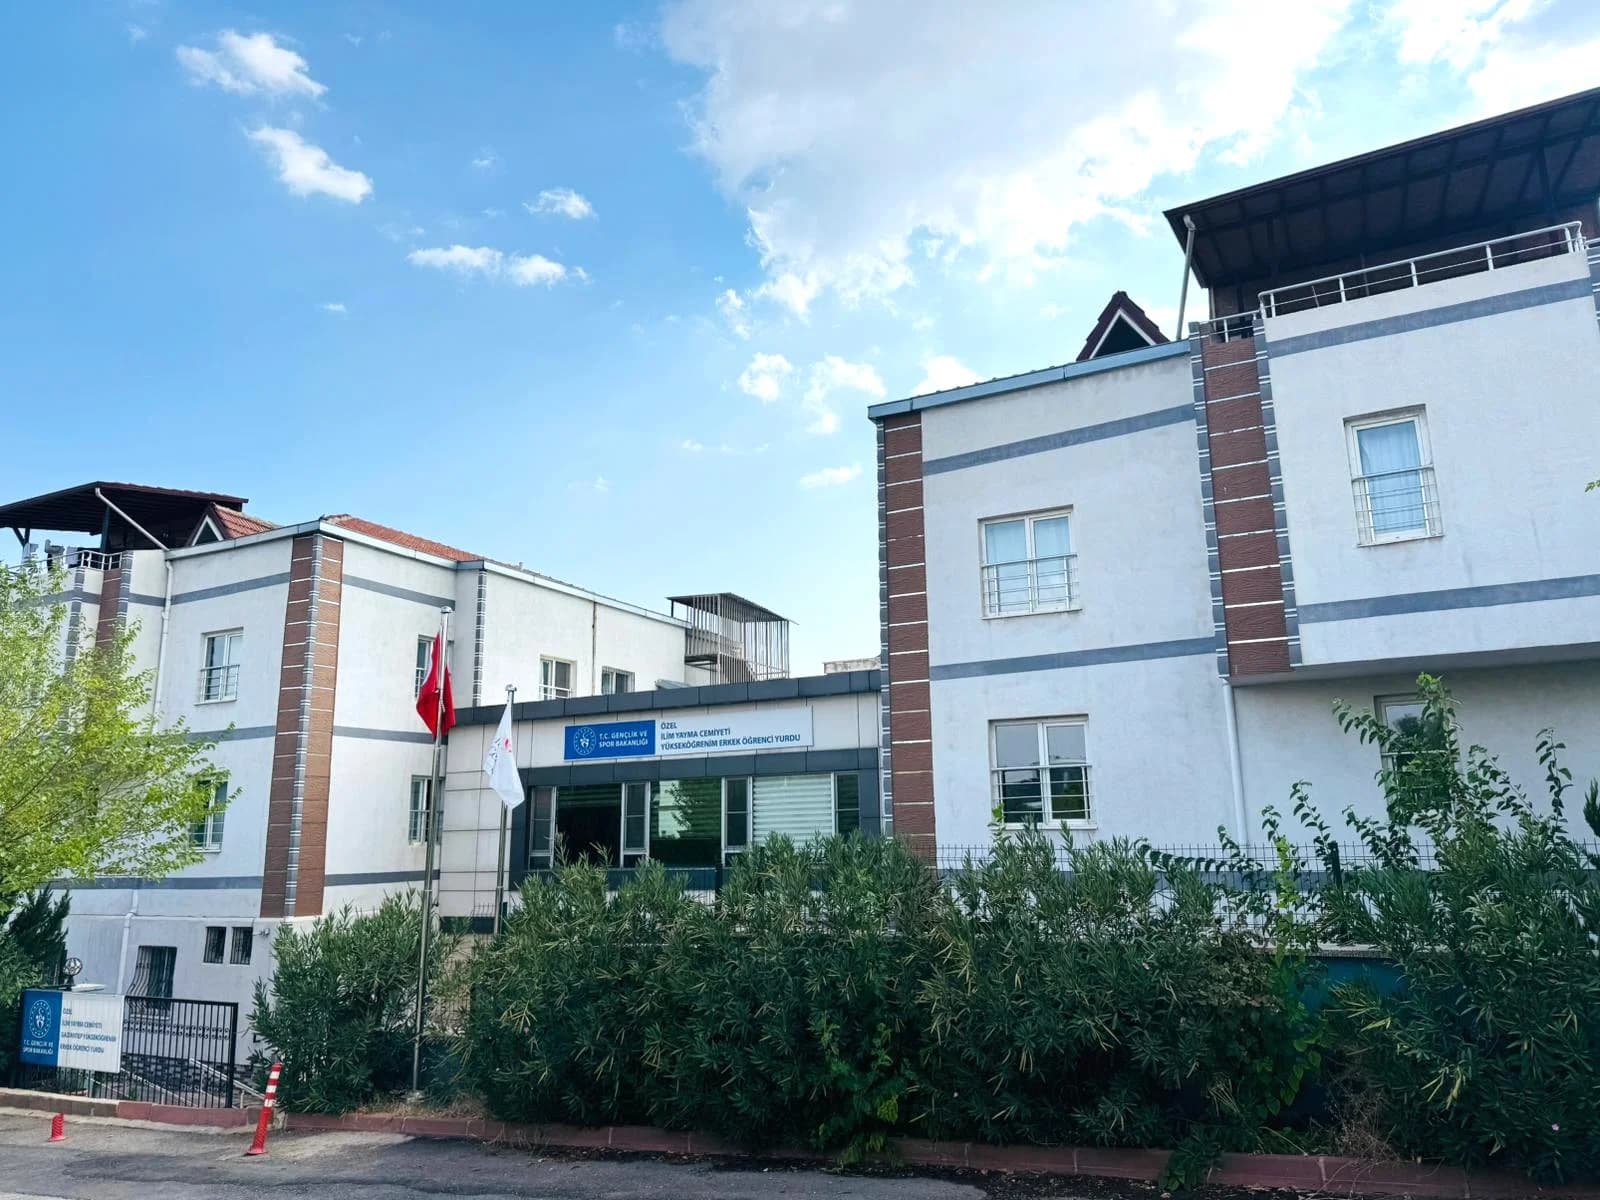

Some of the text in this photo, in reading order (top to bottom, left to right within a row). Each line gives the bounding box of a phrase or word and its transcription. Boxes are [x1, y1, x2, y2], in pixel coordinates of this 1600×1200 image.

[661, 721, 677, 729] ÖZEL
[611, 730, 638, 739] GENÇLİK
[640, 729, 648, 737] VE
[675, 730, 698, 739] YAYMA
[699, 727, 731, 737] CEMİYETİ
[599, 738, 648, 748] SPOR BAKANLIĞI
[661, 733, 801, 750] YÜKSEKÖĞRENİM ERKEK ÖĞRENCİ YURDU
